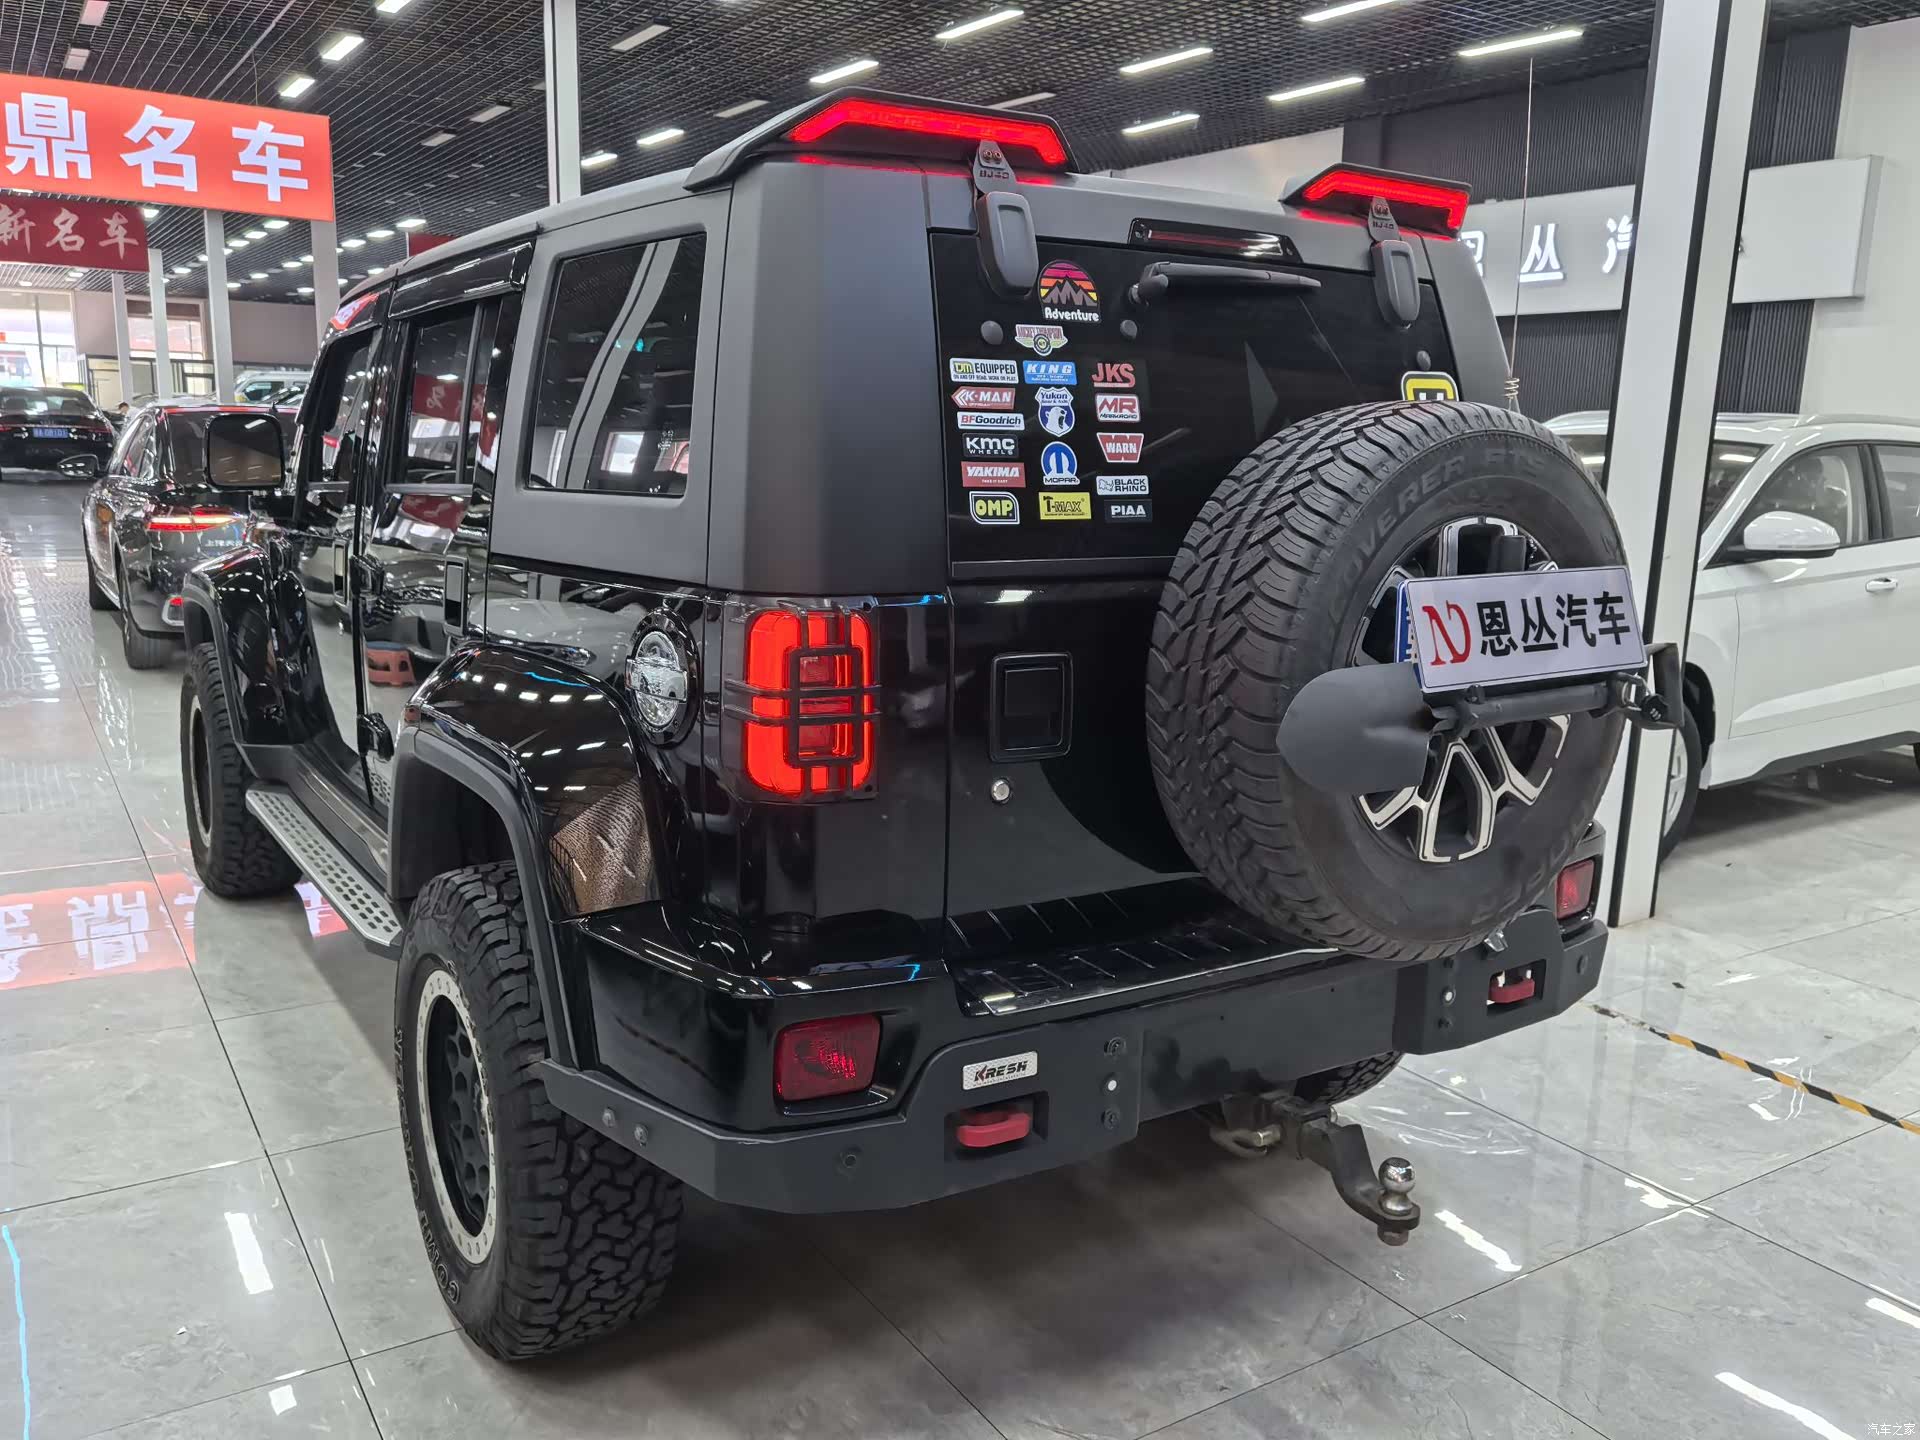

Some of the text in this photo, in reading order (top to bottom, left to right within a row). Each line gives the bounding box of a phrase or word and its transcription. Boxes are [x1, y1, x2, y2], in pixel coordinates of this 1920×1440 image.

[5, 92, 309, 202] 鼎名车
[1044, 306, 1100, 322] Adventure
[974, 362, 1016, 375] EQUIPPED
[1026, 363, 1073, 374] KING
[1091, 362, 1136, 388] JKS
[1040, 392, 1068, 400] Yukon
[1099, 397, 1137, 414] MR
[961, 415, 1021, 426] BFGoodrich
[1105, 442, 1138, 454] WARN
[966, 466, 1020, 478] YAKIMA
[975, 499, 1014, 517] OMP
[1111, 505, 1146, 516] PIAA
[1475, 591, 1632, 657] 恩丛汽车
[974, 1059, 1028, 1082] KRESH
